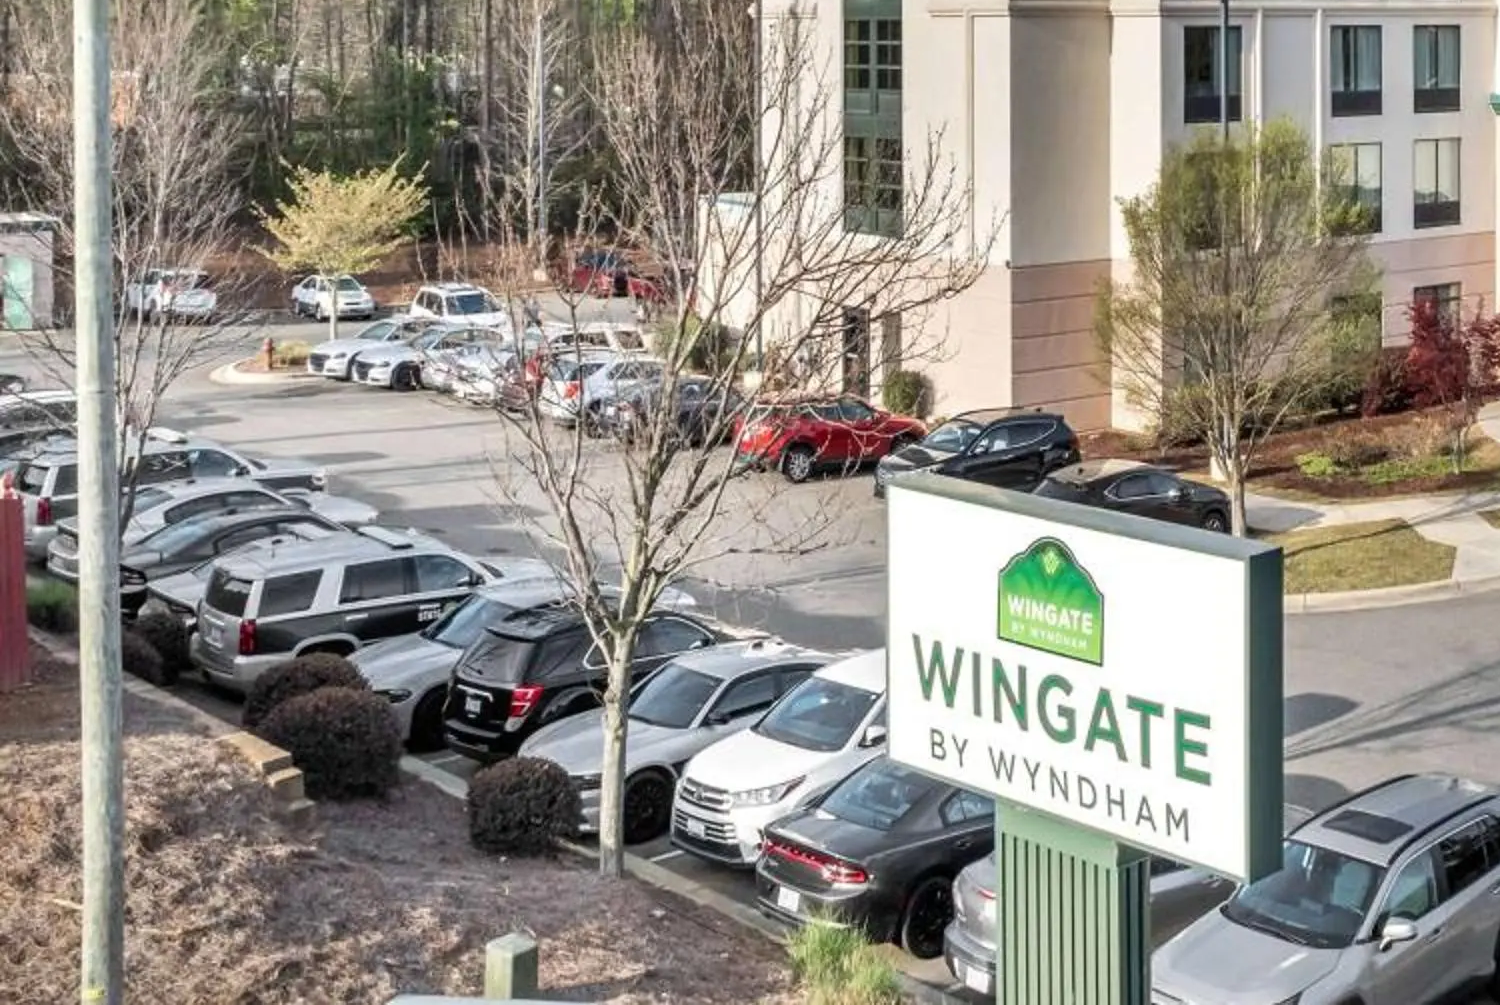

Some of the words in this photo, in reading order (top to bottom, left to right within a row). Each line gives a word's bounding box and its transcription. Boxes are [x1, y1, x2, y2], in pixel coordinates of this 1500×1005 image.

[1007, 595, 1093, 635] WINGATE
[1011, 620, 1025, 634] BY
[1030, 627, 1087, 650] WYNDHAM
[912, 633, 1212, 786] WINGATE
[930, 728, 968, 768] BY
[988, 746, 1190, 841] WYNDHAM
